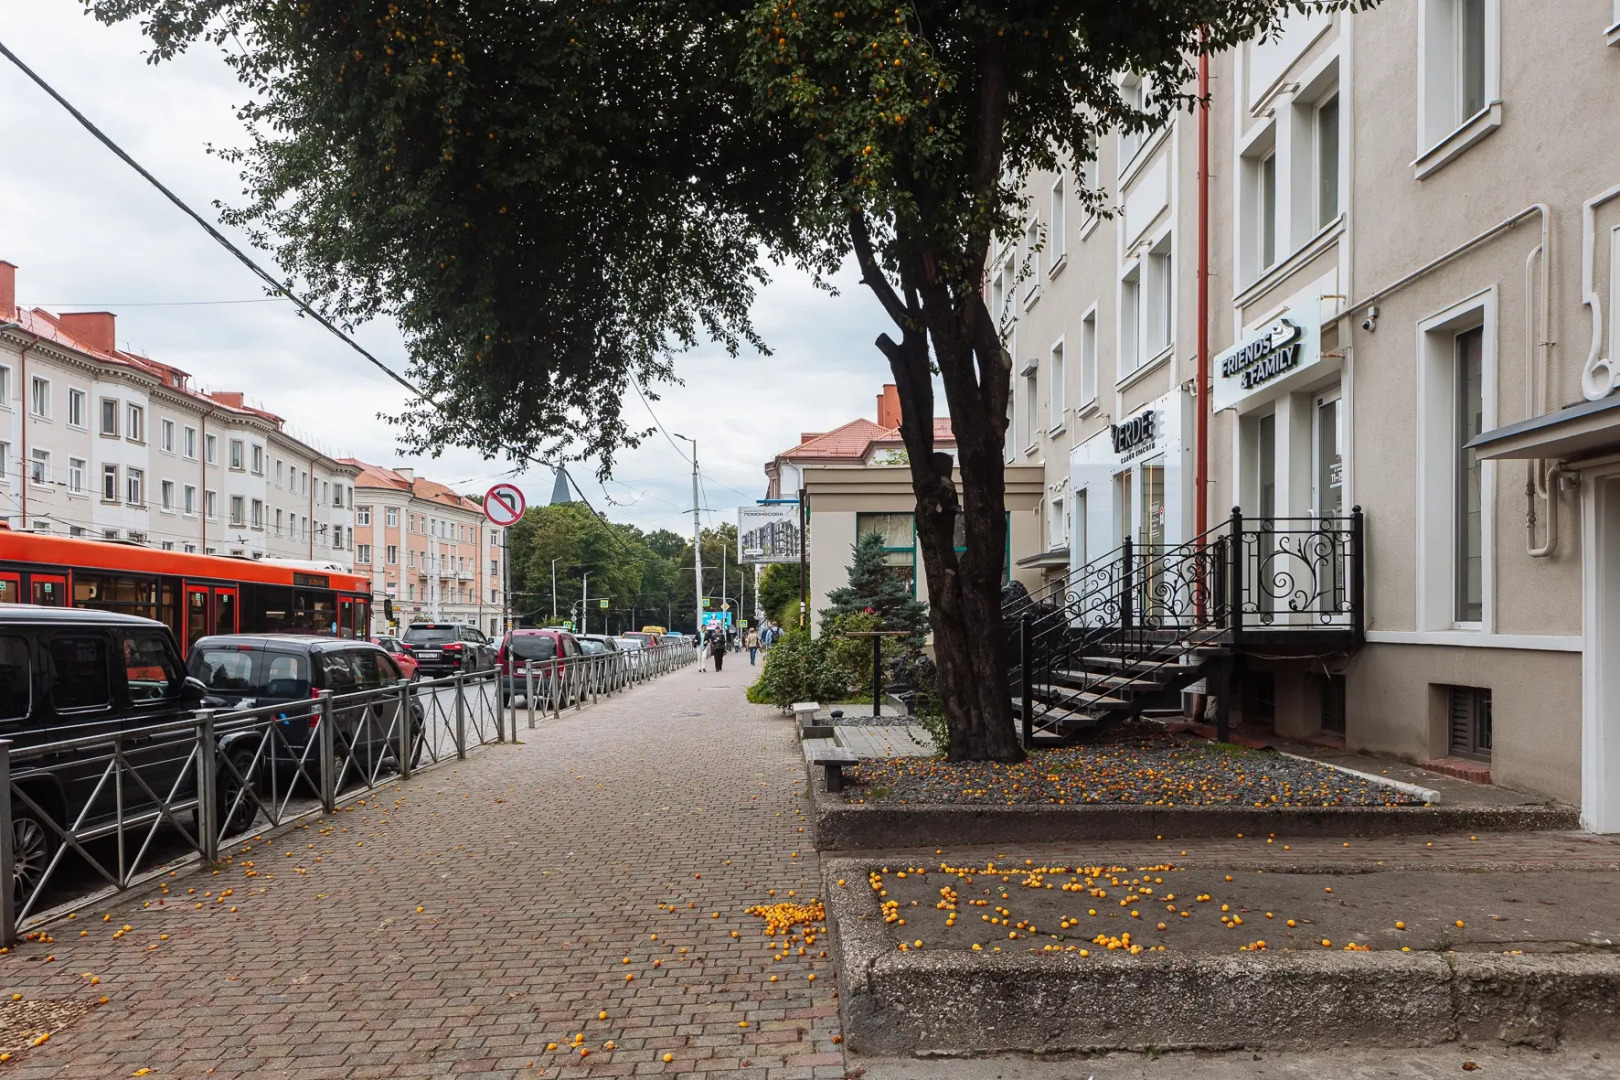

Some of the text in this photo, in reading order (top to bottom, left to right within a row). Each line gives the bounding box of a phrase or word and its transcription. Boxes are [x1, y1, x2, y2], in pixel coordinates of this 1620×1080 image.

[1222, 333, 1272, 377] FRIENDS
[1241, 344, 1300, 389] & FAMILY
[1111, 411, 1154, 453] VERDE
